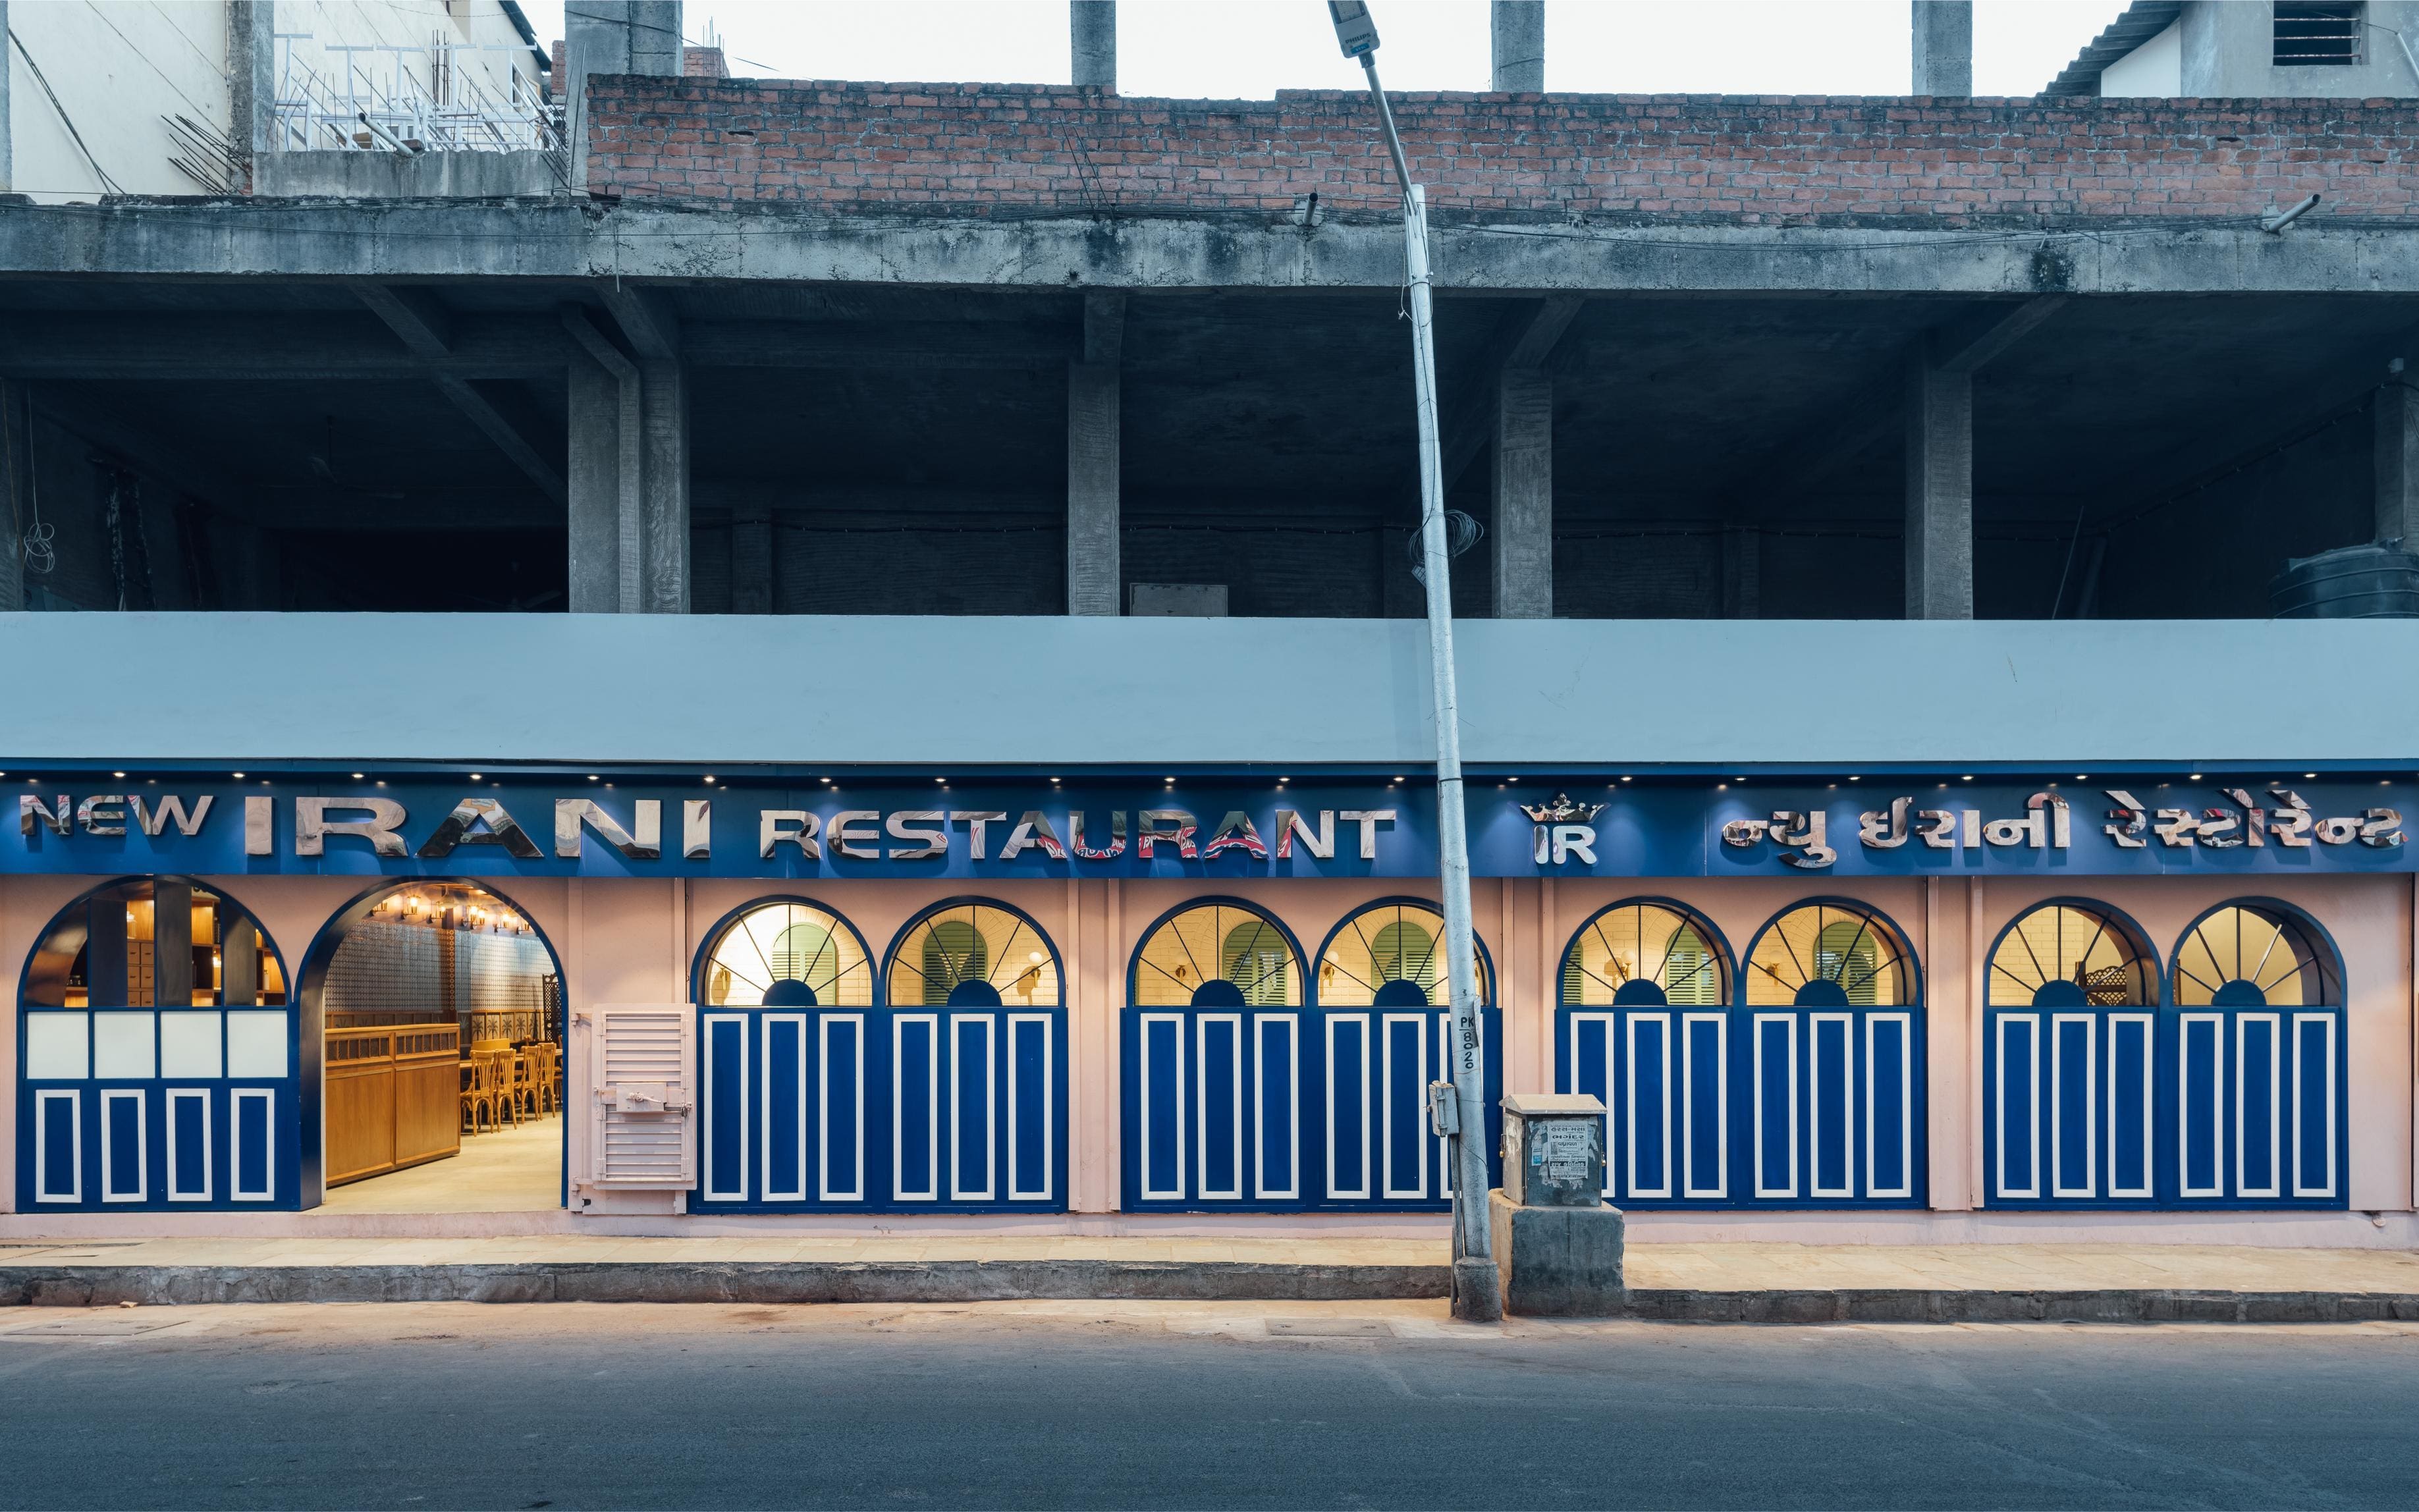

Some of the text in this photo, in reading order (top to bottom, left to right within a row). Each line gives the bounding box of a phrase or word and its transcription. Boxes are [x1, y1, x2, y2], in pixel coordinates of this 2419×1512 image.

[1345, 33, 1371, 43] PHILIPS
[20, 795, 1397, 859] NEW IRANI RESTAURANT
[1534, 824, 1597, 865] IR
[1722, 811, 1837, 869] ન્યુ
[1859, 792, 2071, 849] ઈરાની
[1460, 1016, 1475, 1028] PK
